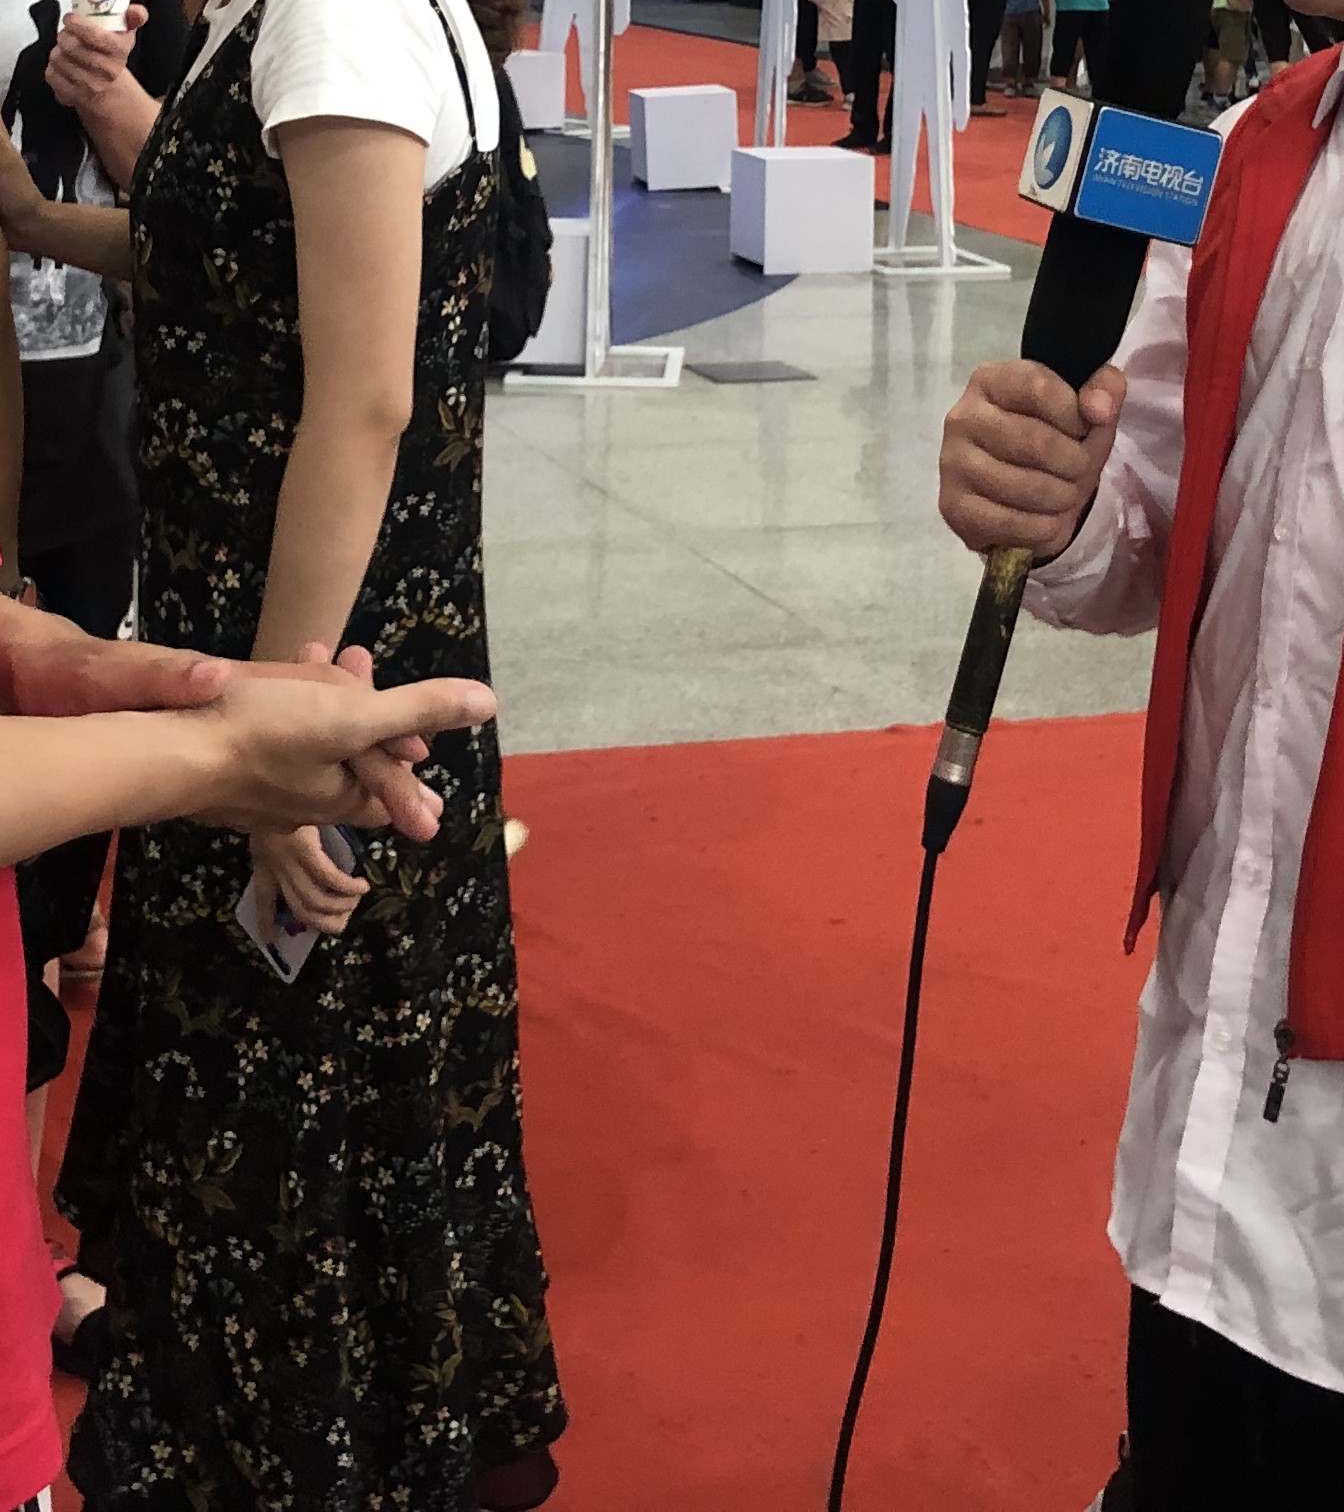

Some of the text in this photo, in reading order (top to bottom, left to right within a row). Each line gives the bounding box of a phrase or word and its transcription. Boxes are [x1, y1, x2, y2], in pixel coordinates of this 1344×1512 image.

[1093, 147, 1204, 196] 济南电视台
